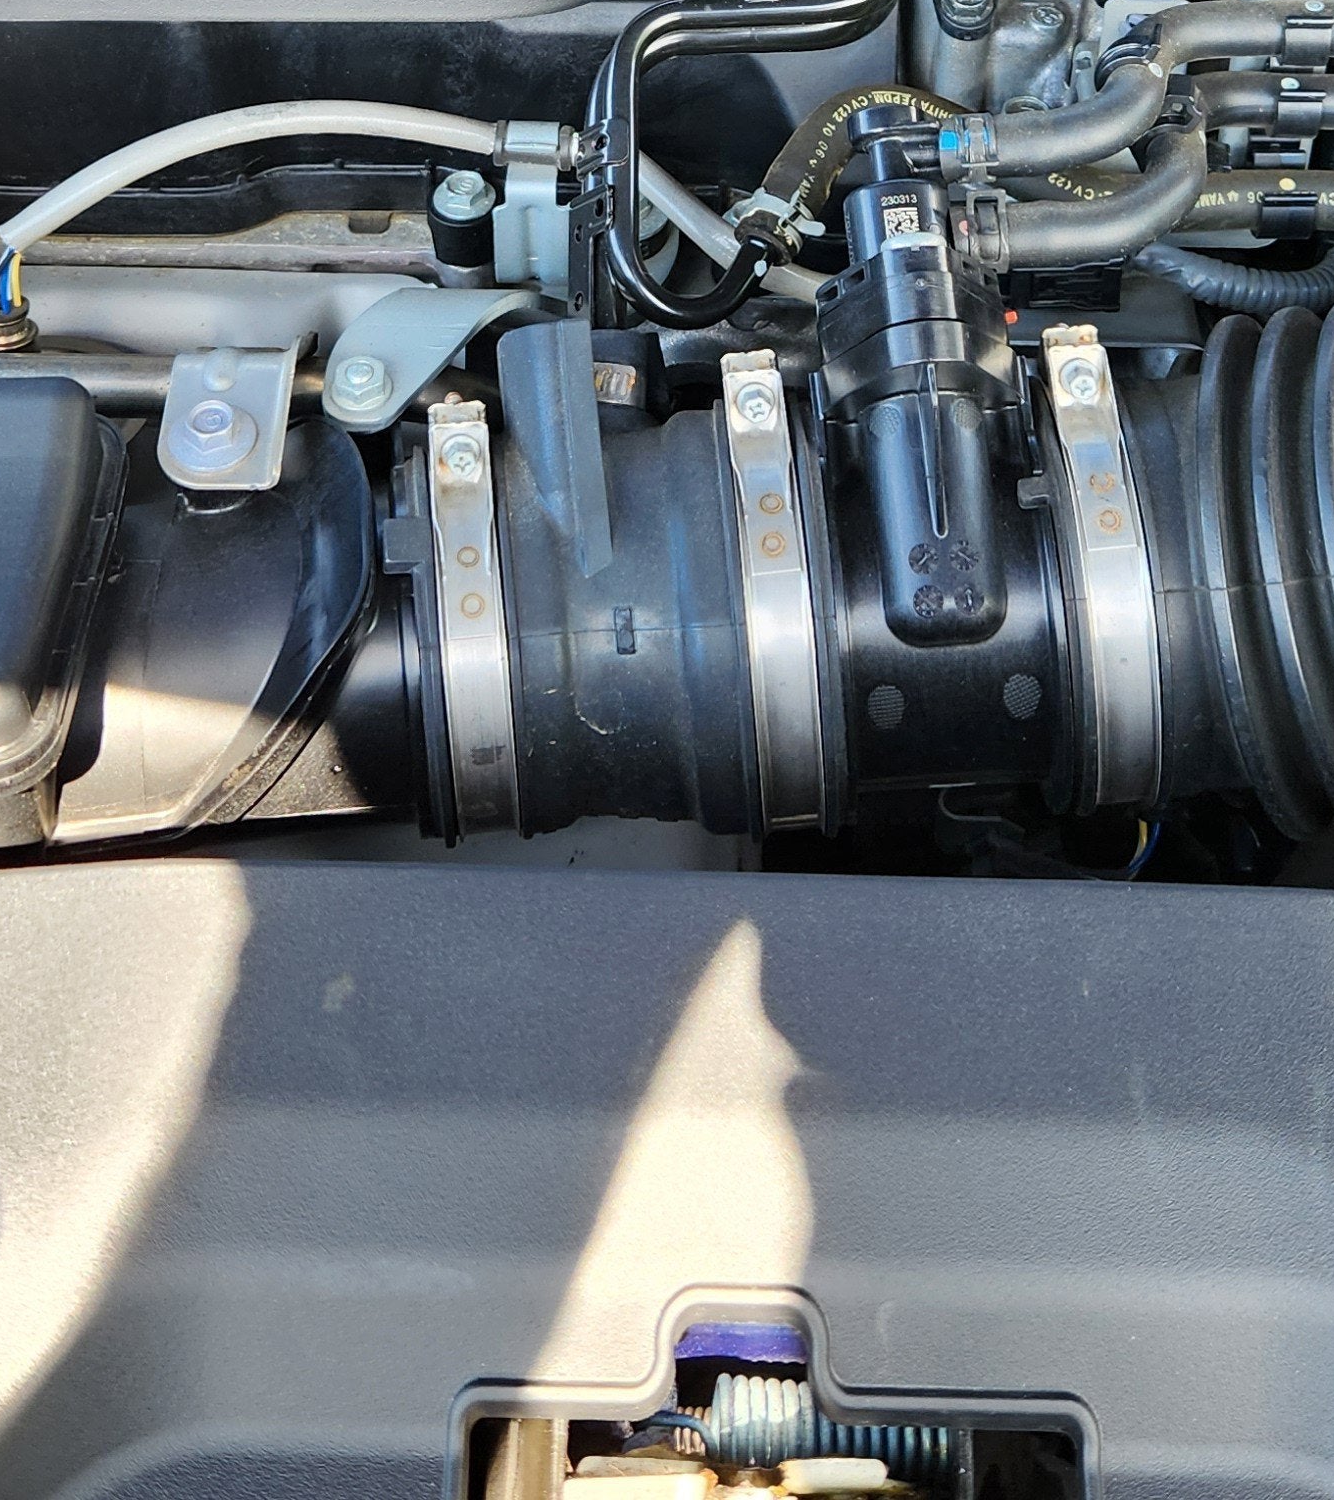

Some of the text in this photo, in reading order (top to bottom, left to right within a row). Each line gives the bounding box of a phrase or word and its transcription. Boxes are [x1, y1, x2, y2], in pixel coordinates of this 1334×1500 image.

[822, 122, 836, 137] 10
[815, 140, 829, 158] 06
[880, 193, 918, 207] 230313
